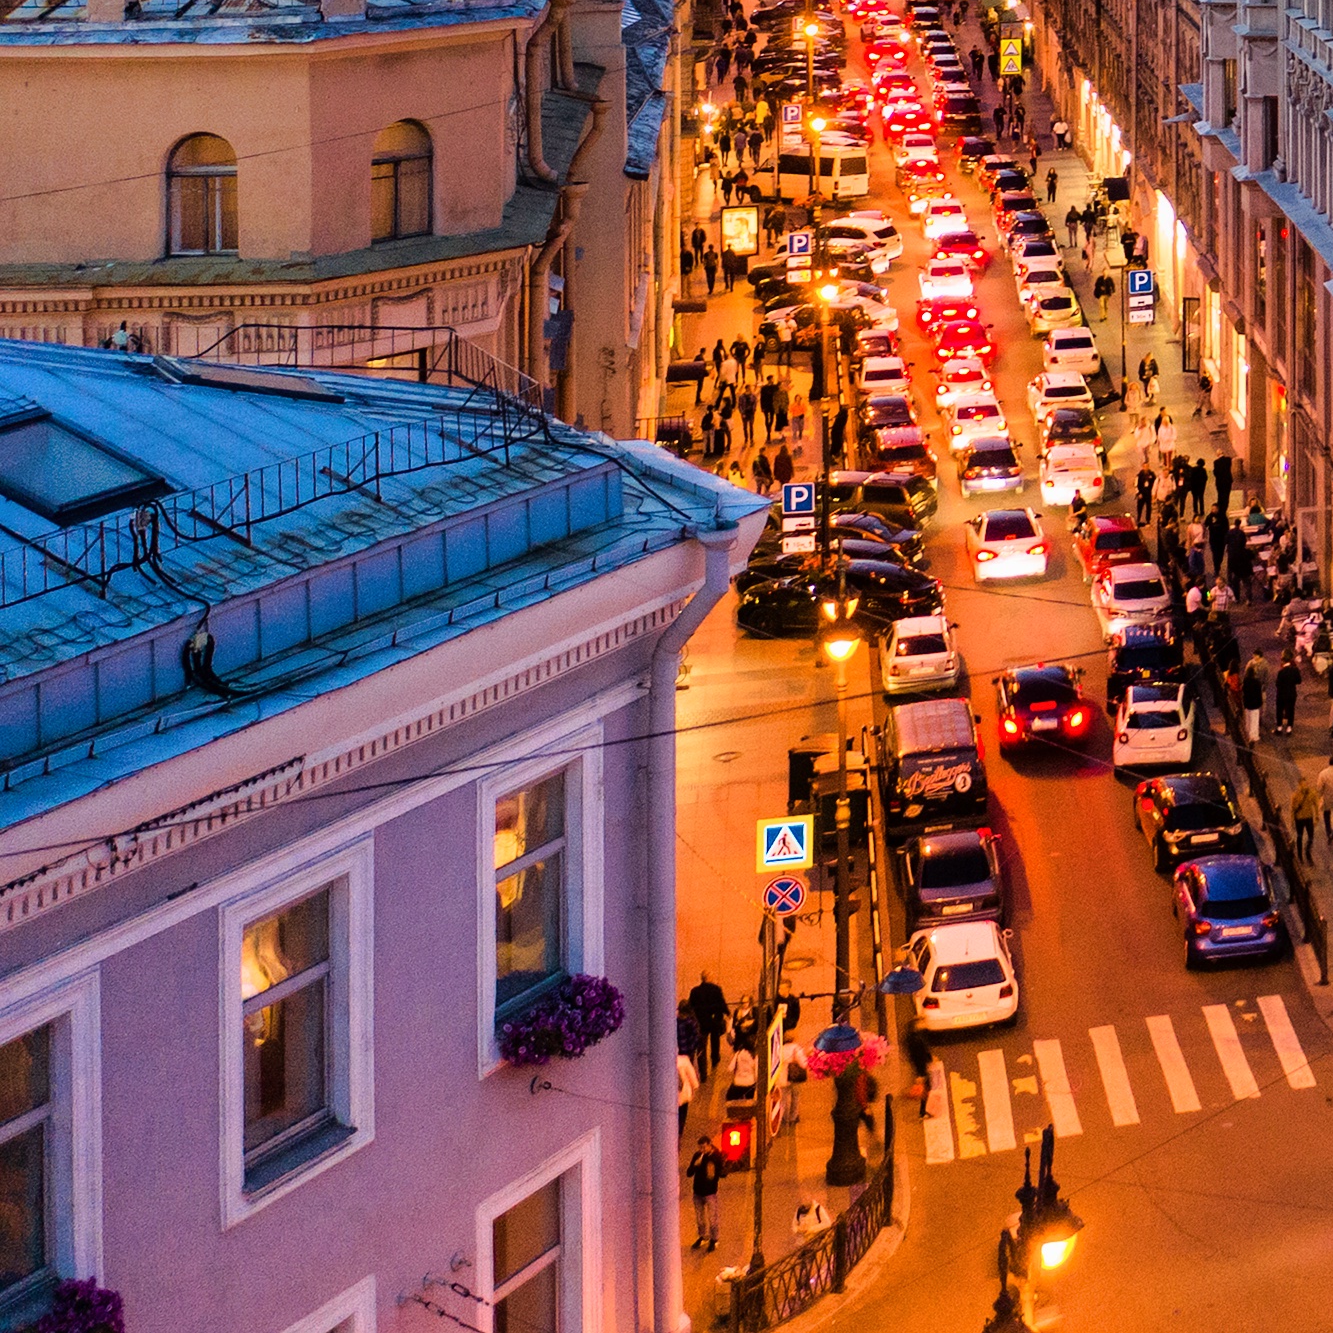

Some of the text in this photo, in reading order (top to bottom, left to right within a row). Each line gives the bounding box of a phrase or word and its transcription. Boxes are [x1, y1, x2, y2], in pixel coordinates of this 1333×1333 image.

[787, 107, 798, 121] P
[793, 235, 807, 253] P
[1135, 272, 1149, 291] P
[790, 486, 809, 511] P
